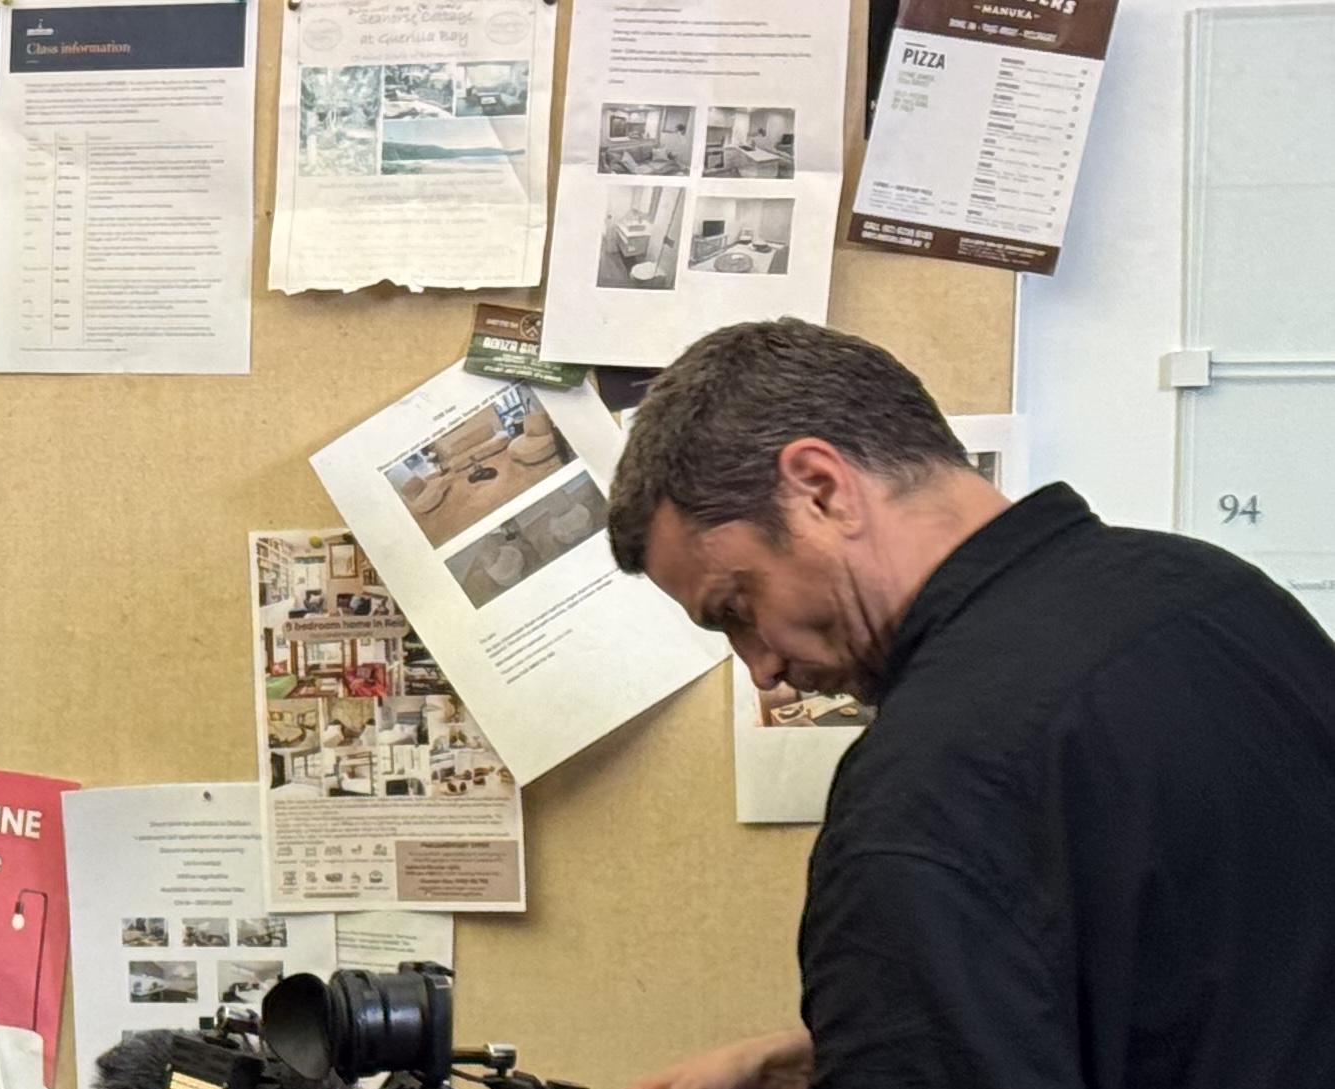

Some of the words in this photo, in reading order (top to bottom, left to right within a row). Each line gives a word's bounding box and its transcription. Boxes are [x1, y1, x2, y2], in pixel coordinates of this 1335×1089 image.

[360, 33, 374, 45] at
[439, 30, 469, 47] Bay
[26, 42, 58, 55] Class
[60, 40, 131, 55] information
[902, 48, 946, 70] PIZZA
[1219, 494, 1261, 525] 94
[294, 619, 340, 631] bedroom
[342, 620, 371, 631] home
[372, 619, 382, 629] in
